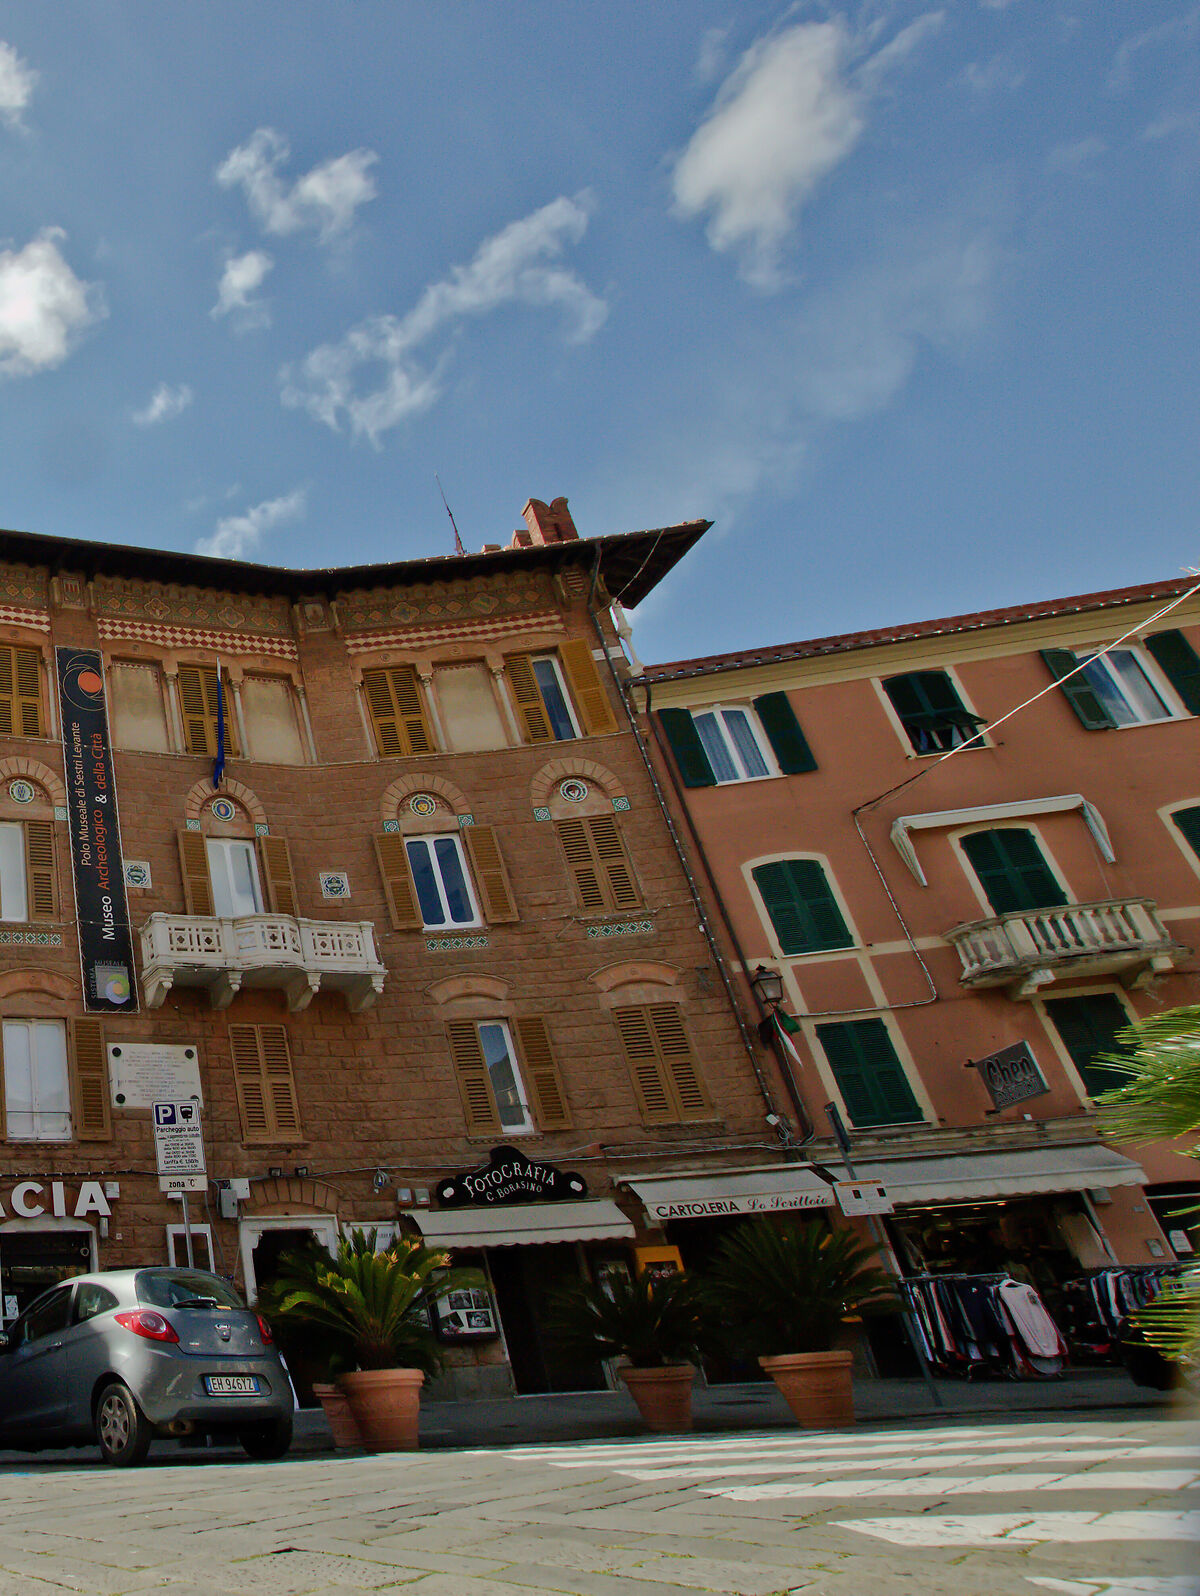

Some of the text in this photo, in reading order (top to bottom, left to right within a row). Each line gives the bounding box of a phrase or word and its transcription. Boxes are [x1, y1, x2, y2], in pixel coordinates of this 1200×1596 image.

[71, 722, 92, 867] Polo Museale di Sestri Levante
[90, 733, 116, 941] Museo Archeologico & della Città
[984, 1056, 1035, 1091] Chen
[157, 1105, 173, 1124] P
[156, 1126, 187, 1134] Parcheggio
[462, 1161, 555, 1198] FOTOGRAFIA
[656, 1200, 740, 1218] CARTOLERIA
[210, 1378, 254, 1391] EH 946YZ
